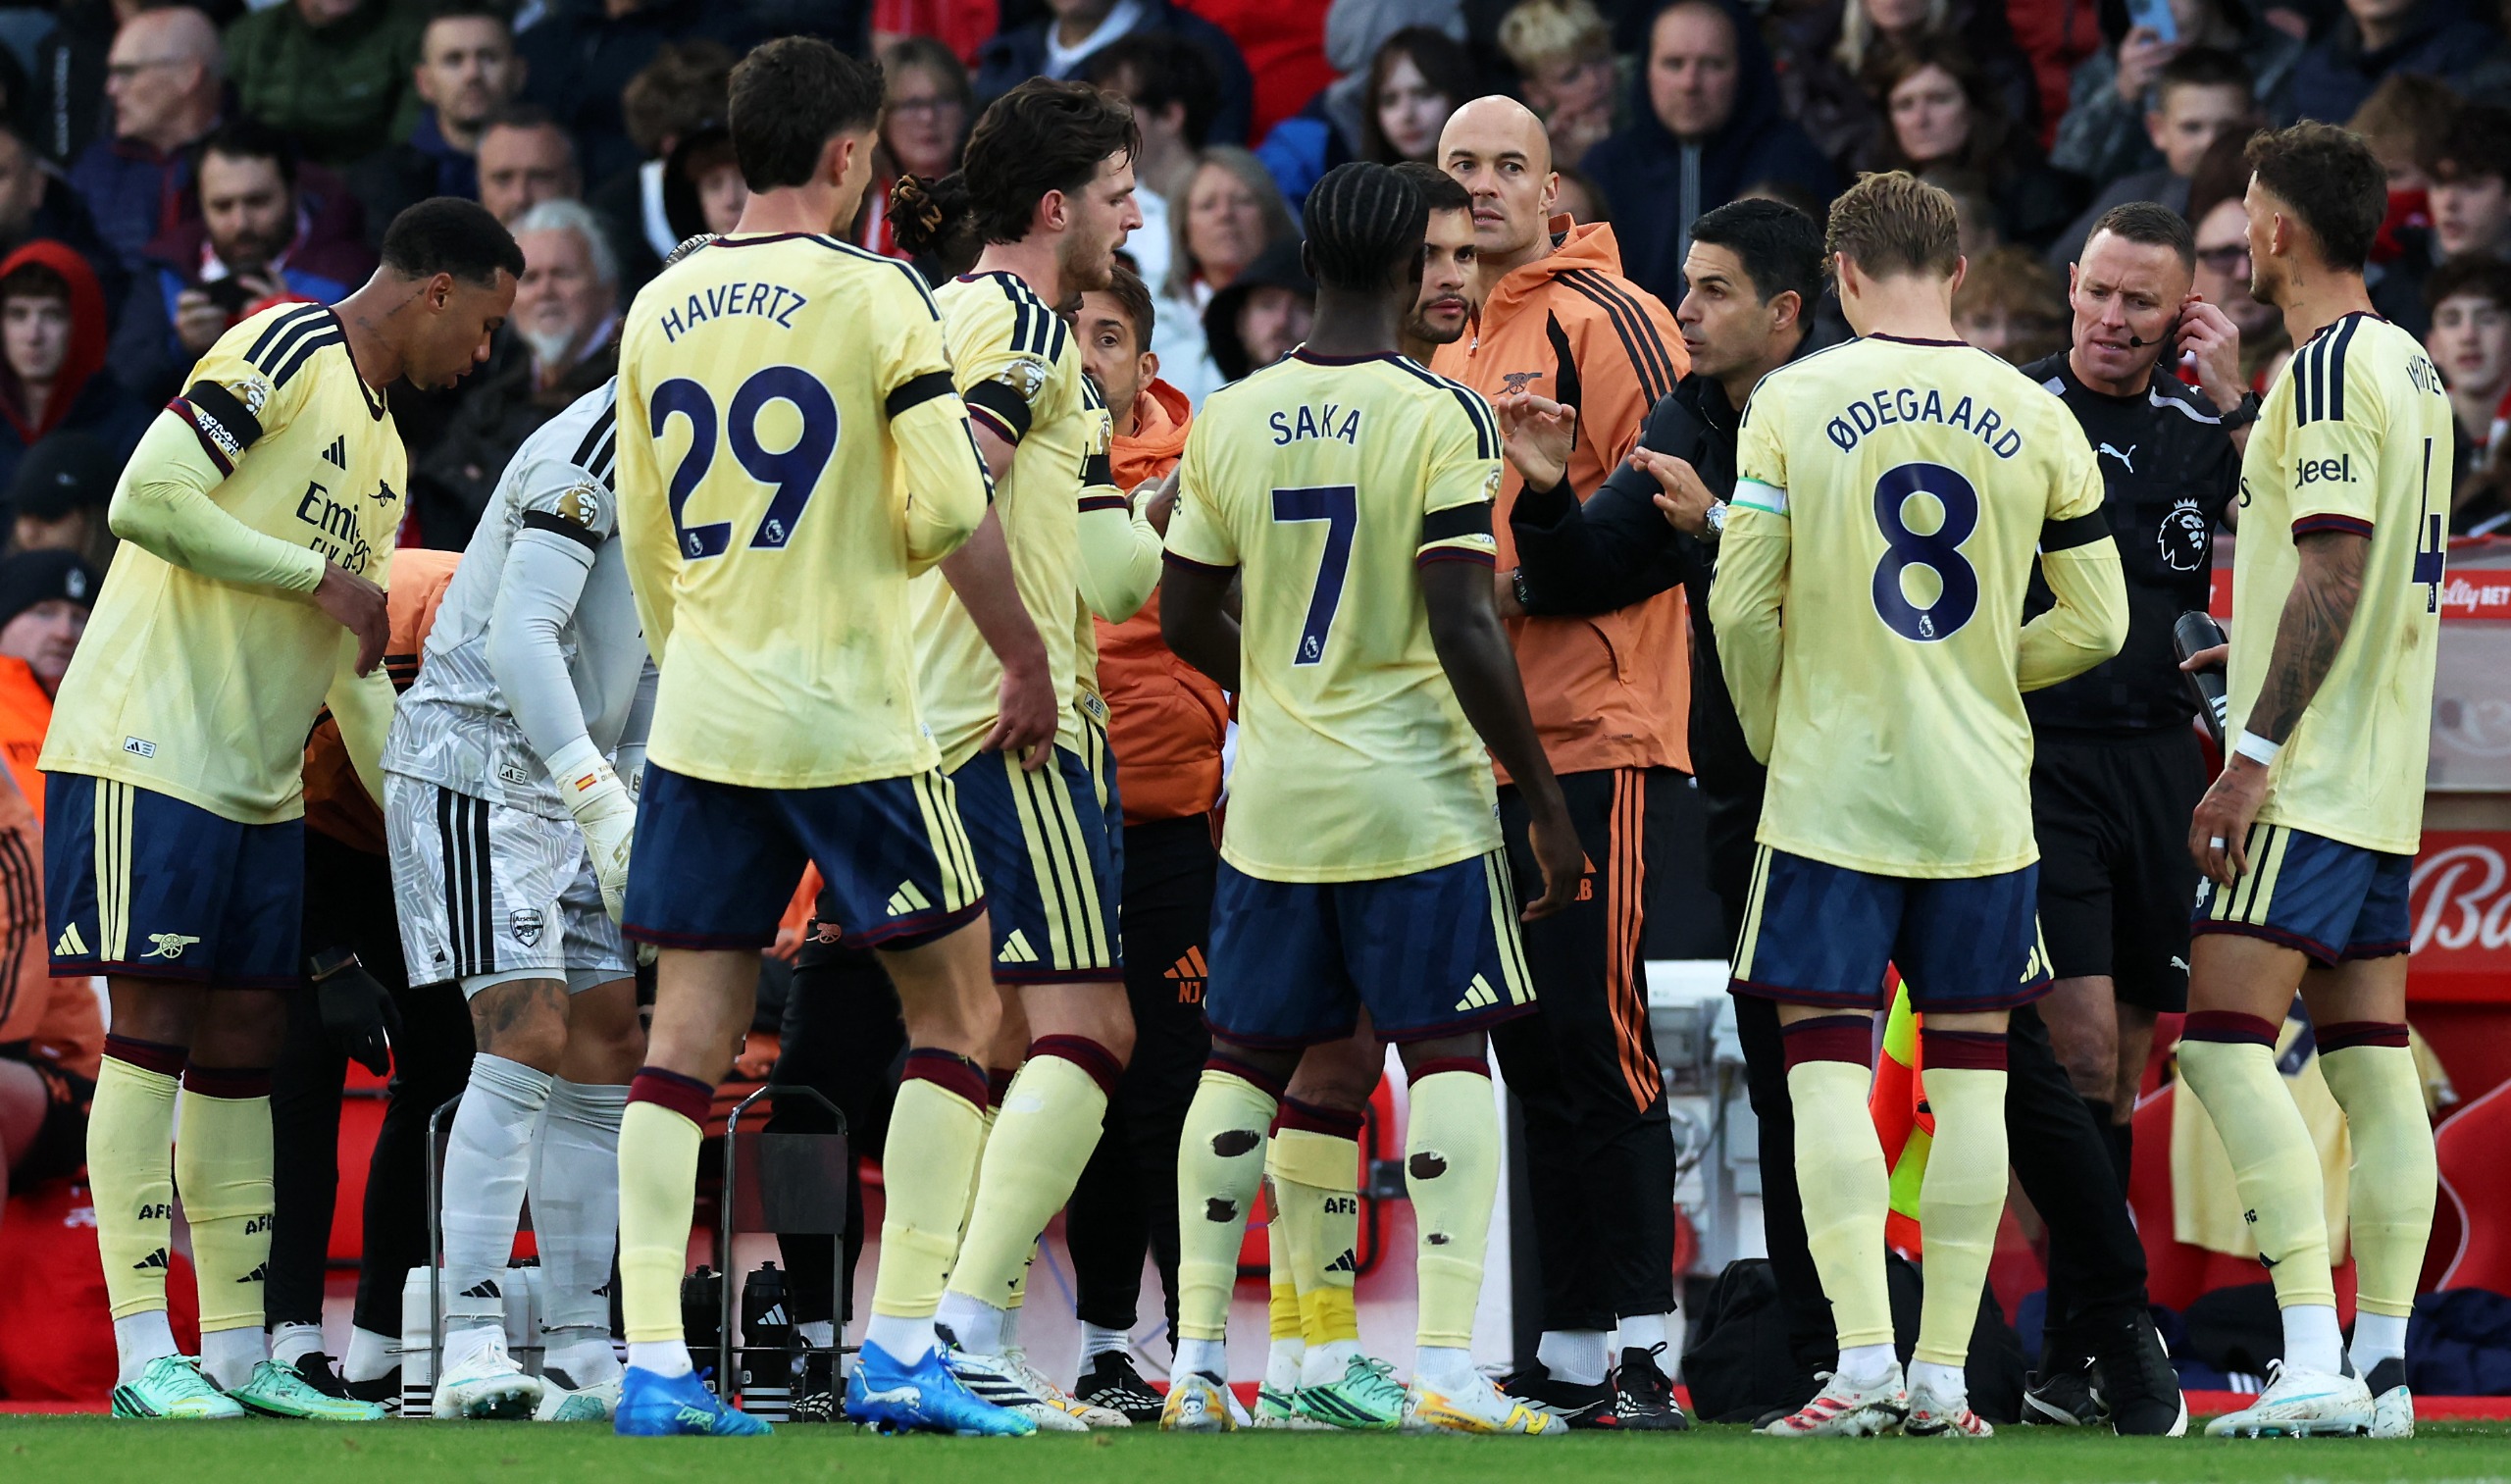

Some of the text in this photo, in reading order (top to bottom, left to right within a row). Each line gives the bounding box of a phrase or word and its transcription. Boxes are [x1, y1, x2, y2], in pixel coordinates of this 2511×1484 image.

[660, 281, 808, 343] HAVERTZ
[1269, 403, 1361, 446] SAKA
[1825, 387, 2024, 460] ØDEGAARD
[649, 364, 841, 561] 29
[1870, 461, 1980, 643] 8
[2411, 435, 2445, 615] 4
[1271, 484, 1359, 667] 7
[1573, 878, 1593, 901] B
[1178, 981, 1202, 1003] NJ
